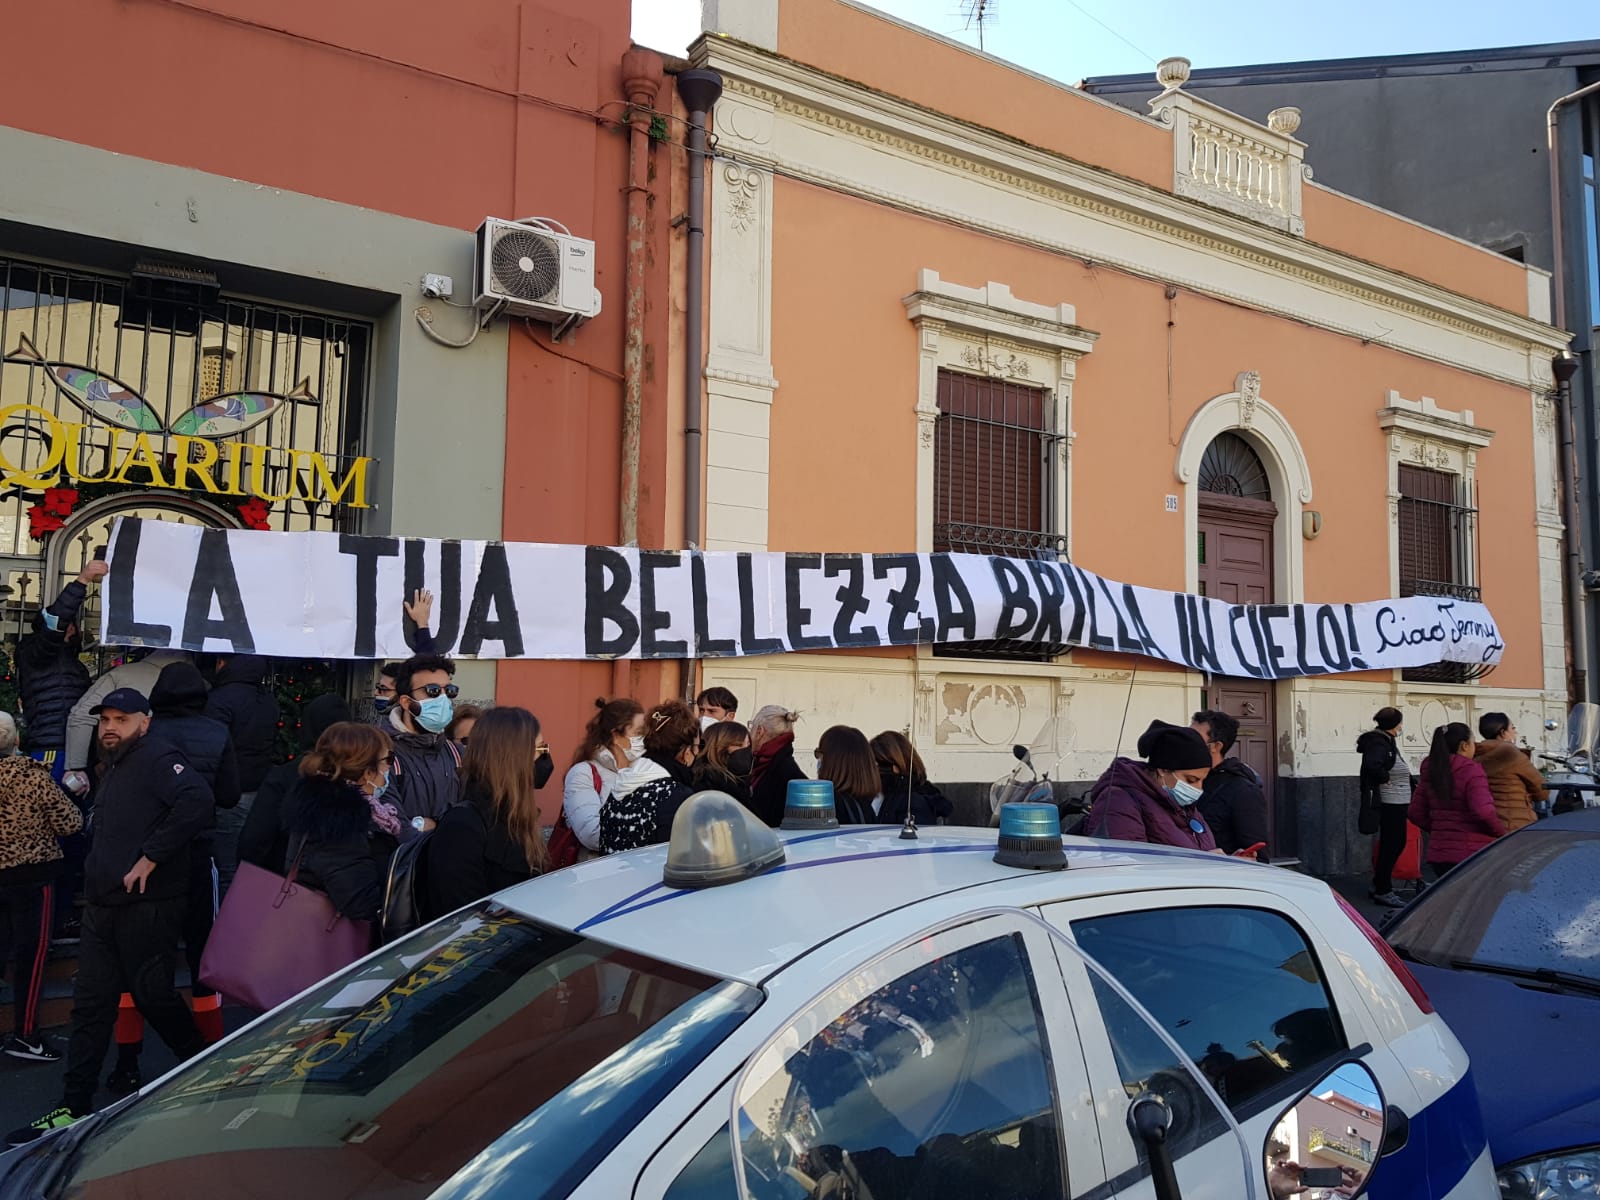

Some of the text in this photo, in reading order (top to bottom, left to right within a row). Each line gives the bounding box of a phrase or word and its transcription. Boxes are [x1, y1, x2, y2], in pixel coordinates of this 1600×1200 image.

[570, 246, 586, 256] beko
[107, 517, 1369, 678] LA TUA BELLEZZA BRILLA IN CIELO!
[1376, 602, 1504, 660] Ciao Jenny
